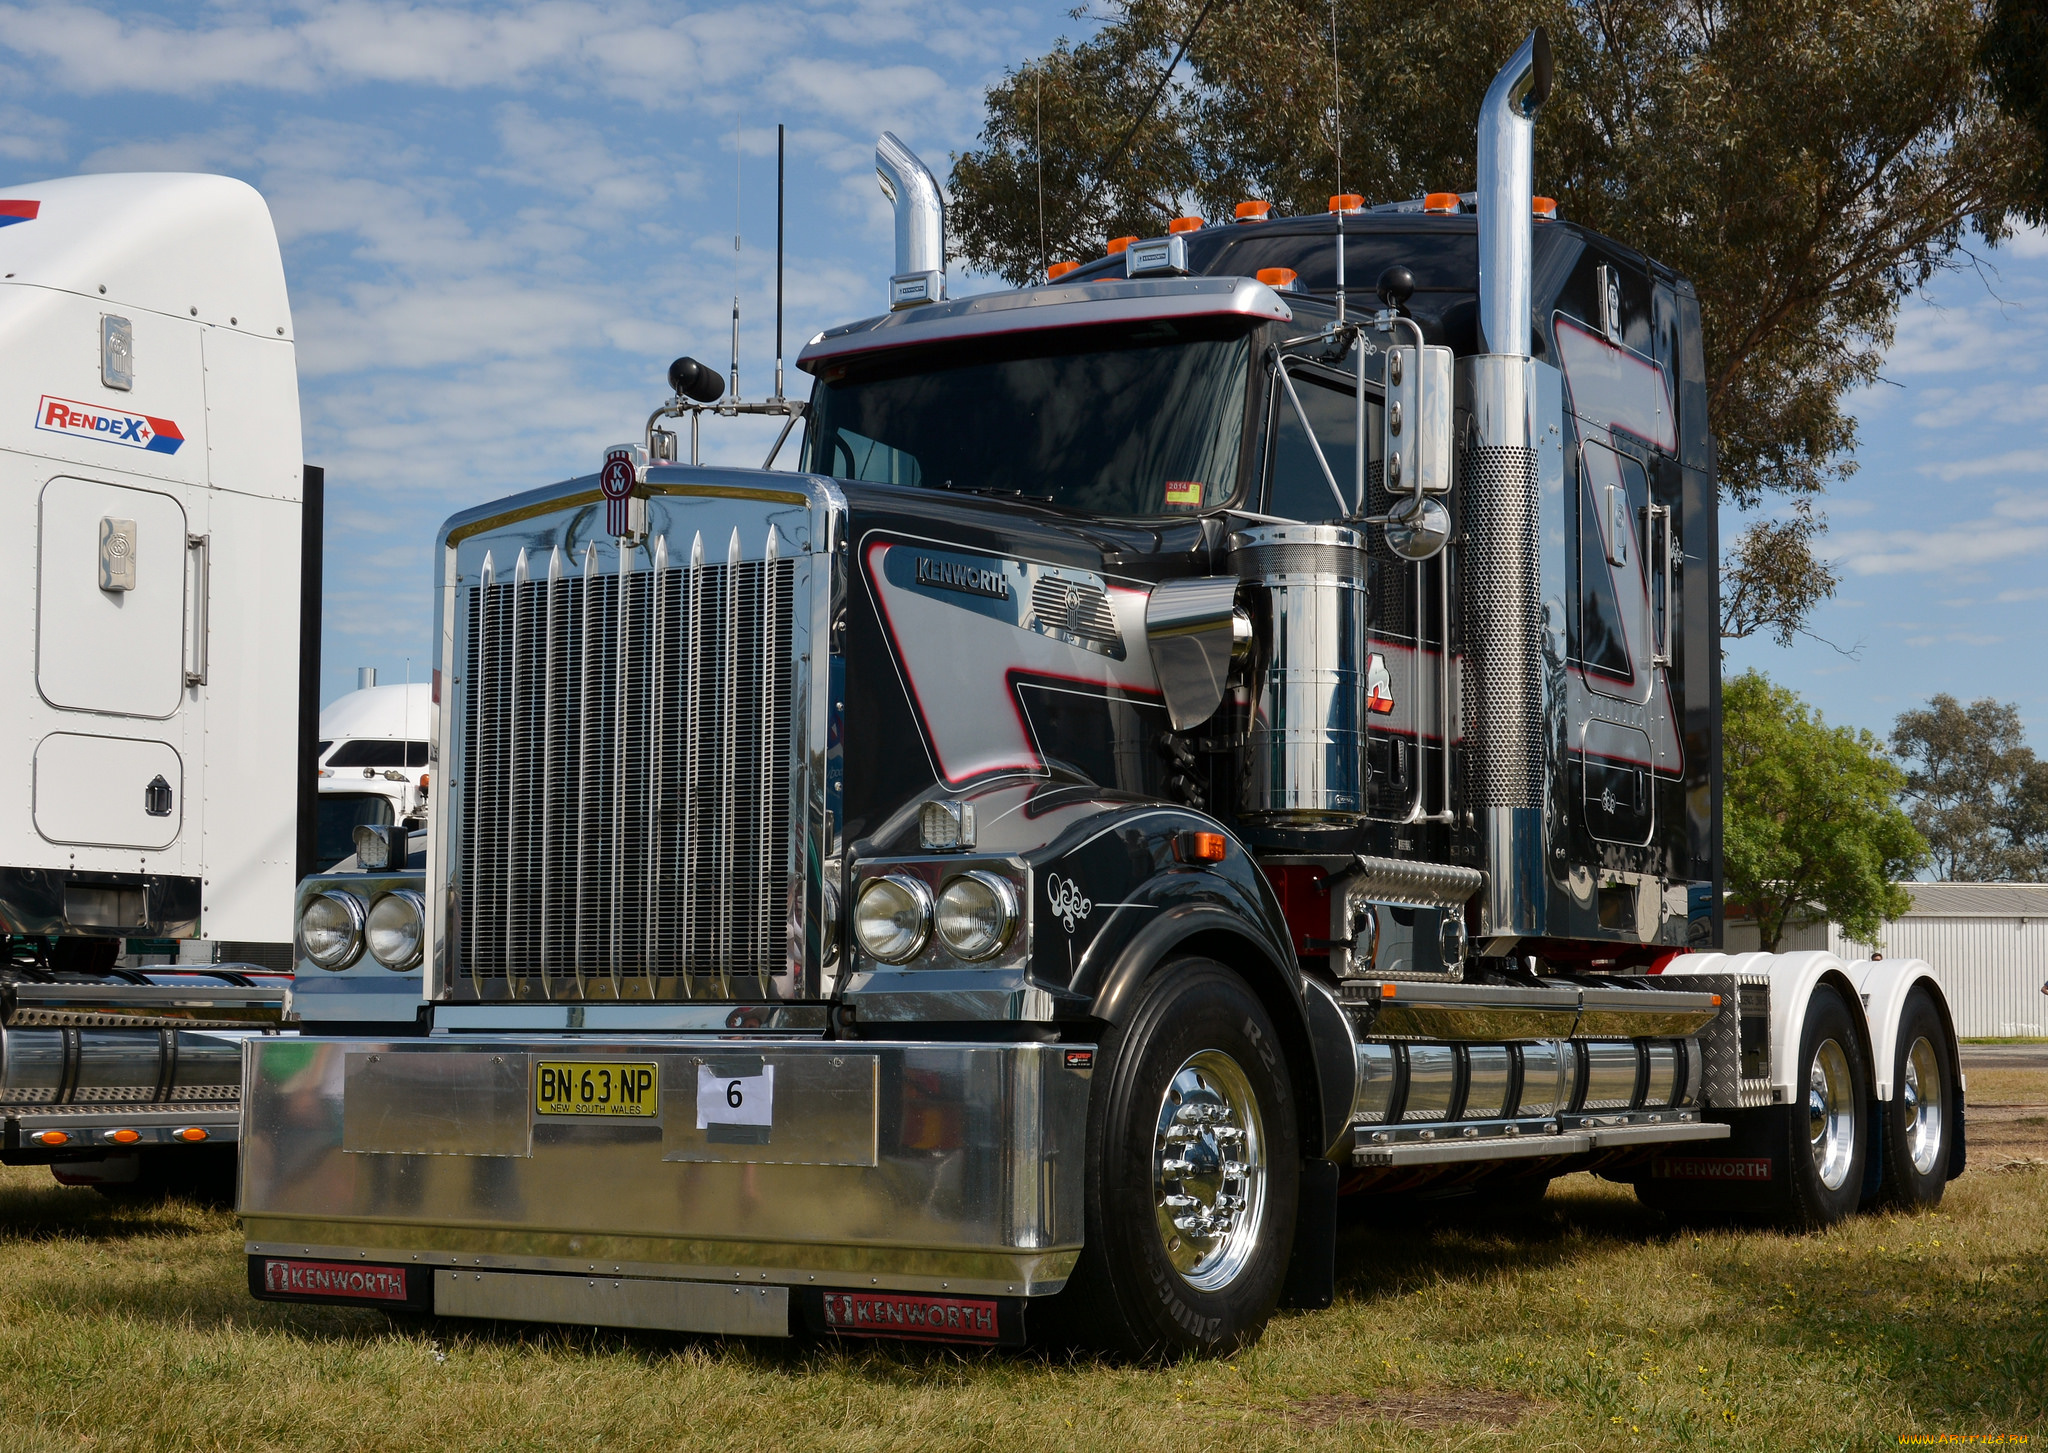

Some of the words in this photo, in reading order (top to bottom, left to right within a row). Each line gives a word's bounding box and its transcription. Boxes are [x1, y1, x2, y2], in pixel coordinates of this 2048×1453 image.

[1168, 482, 1187, 490] 2014
[916, 556, 1009, 595] KENWORTH
[726, 1080, 743, 1109] 6
[550, 1103, 571, 1113] NEW
[575, 1104, 606, 1114] SOUTH
[611, 1105, 641, 1115] WALES
[1673, 1162, 1768, 1177] KENWORTH
[292, 1267, 402, 1294] KENWORTH
[856, 1300, 992, 1331] KENWORTH
